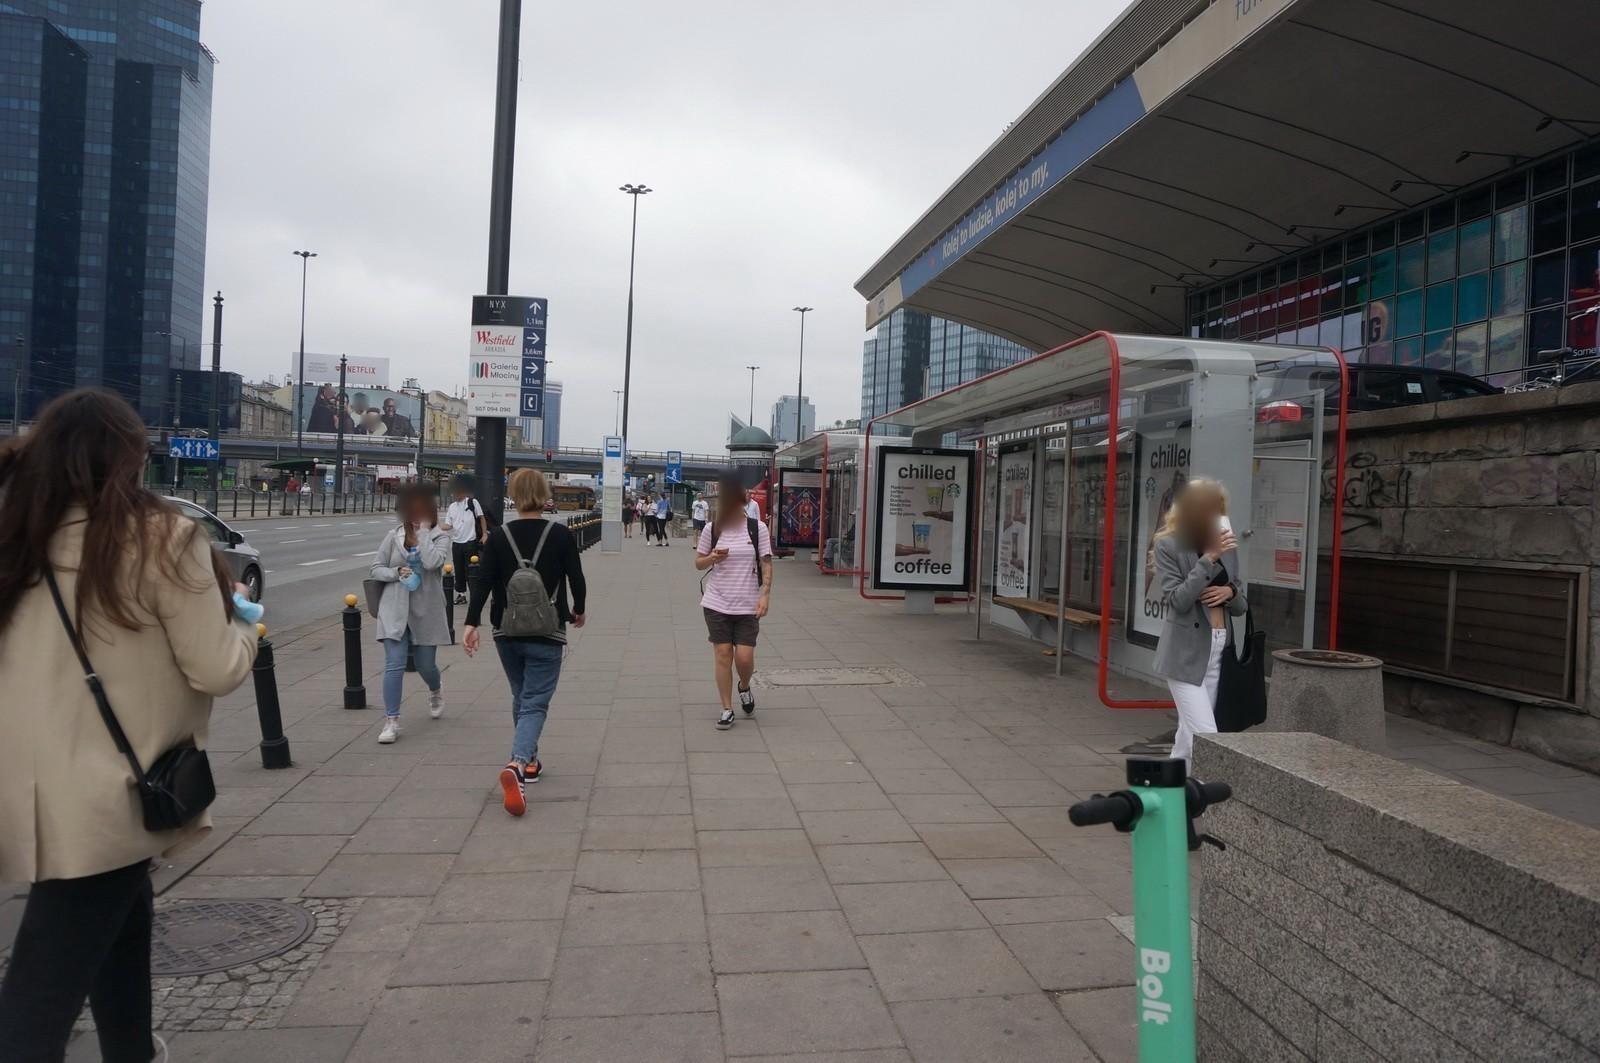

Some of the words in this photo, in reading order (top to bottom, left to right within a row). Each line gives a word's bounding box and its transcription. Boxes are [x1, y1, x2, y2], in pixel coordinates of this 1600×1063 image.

[942, 230, 960, 260] Kolej
[960, 229, 968, 245] to
[968, 205, 994, 239] ludzie,
[995, 180, 1018, 218] kolej
[1018, 177, 1029, 199] to
[1031, 161, 1049, 188] my.
[489, 299, 506, 309] NYX
[475, 330, 516, 346] Westfield
[347, 365, 376, 375] NETFLIX
[490, 362, 519, 371] Galeria
[898, 464, 956, 480] chilled
[1006, 463, 1029, 481] chilled
[894, 558, 952, 574] coffee
[1001, 570, 1025, 590] coffee
[1141, 947, 1171, 1025] Bolt
